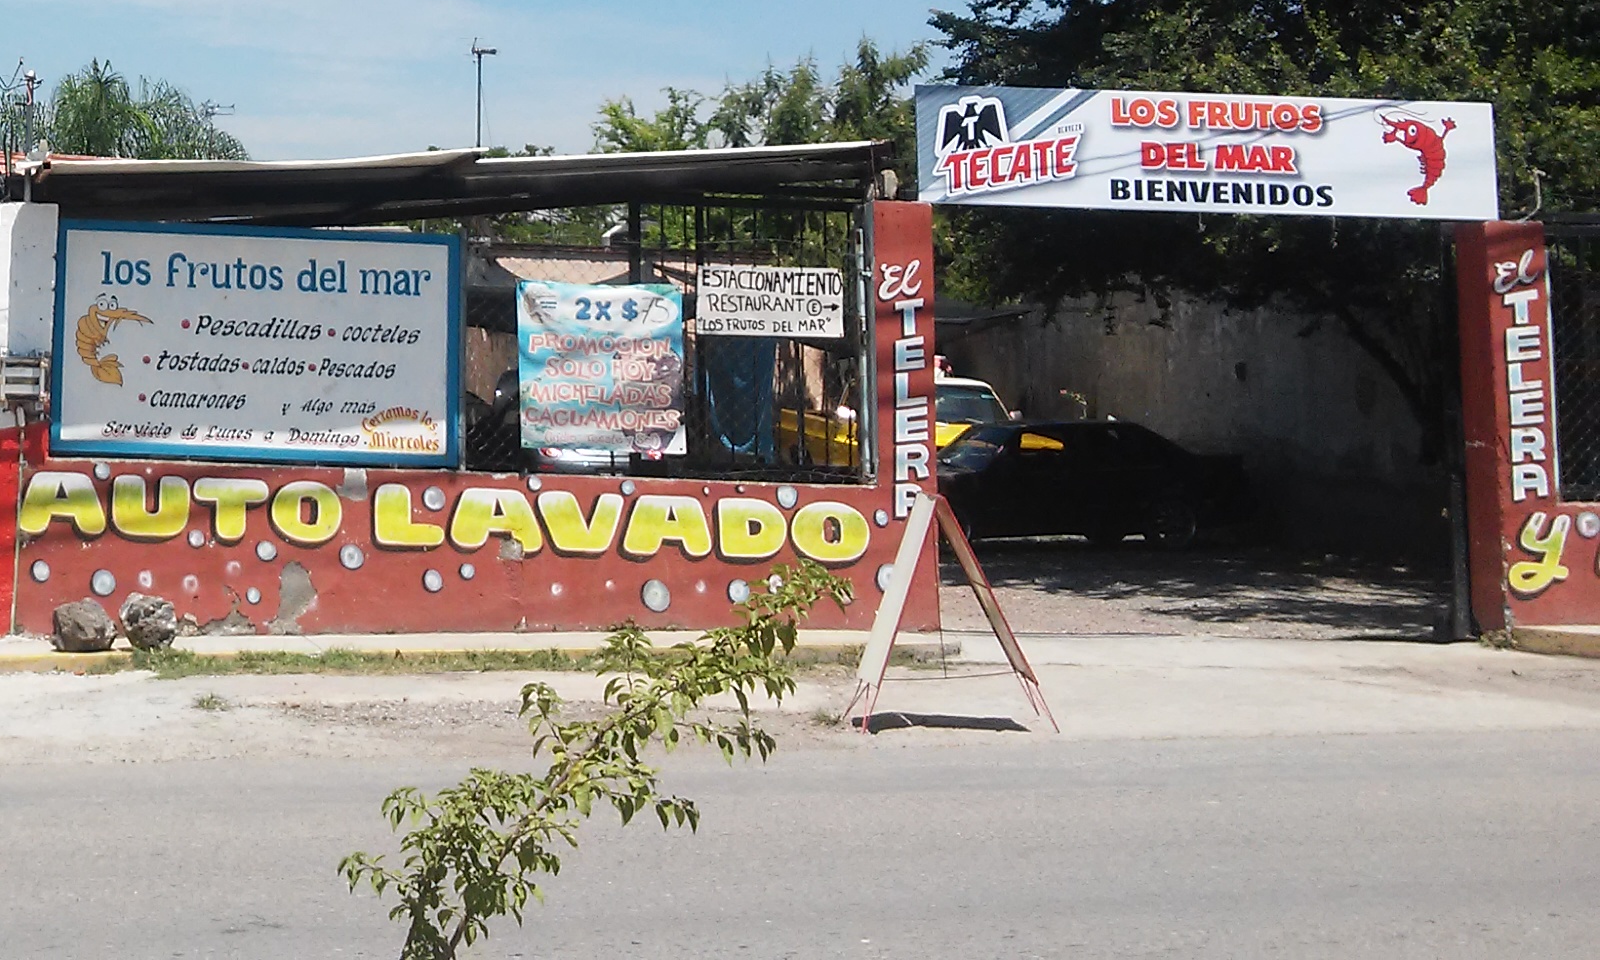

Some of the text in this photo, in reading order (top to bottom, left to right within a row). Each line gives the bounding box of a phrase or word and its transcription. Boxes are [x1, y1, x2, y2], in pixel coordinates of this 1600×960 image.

[1111, 98, 1324, 132] LOS FRUTOS
[942, 135, 1079, 191] TECATE
[1140, 141, 1299, 175] DEL MAR
[1110, 179, 1334, 208] BIENVENIDOS
[100, 250, 152, 286] los
[297, 259, 348, 293] del
[359, 268, 432, 297] mar
[702, 269, 843, 296] ESTACIONAMIENTO
[878, 259, 922, 302] El
[1493, 249, 1539, 294] El
[706, 293, 805, 313] RESTAURANT
[194, 315, 421, 345] Pescadillas cocteles
[726, 318, 766, 331] FRUTOS
[773, 320, 794, 333] DEL
[155, 350, 396, 380] tostadas caldos Pescados
[545, 357, 656, 382] SOLO HOY
[531, 383, 672, 407] MICHELADAS
[1504, 289, 1549, 503] TELERA
[101, 420, 173, 438] Servicio
[181, 423, 199, 440] de
[202, 424, 254, 442] Lunes
[263, 430, 275, 442] a
[361, 406, 420, 433] Cerramos
[525, 406, 681, 431] CAGUAMONES
[368, 431, 440, 453] Miercoles
[19, 471, 873, 564] AUTO LAVADO
